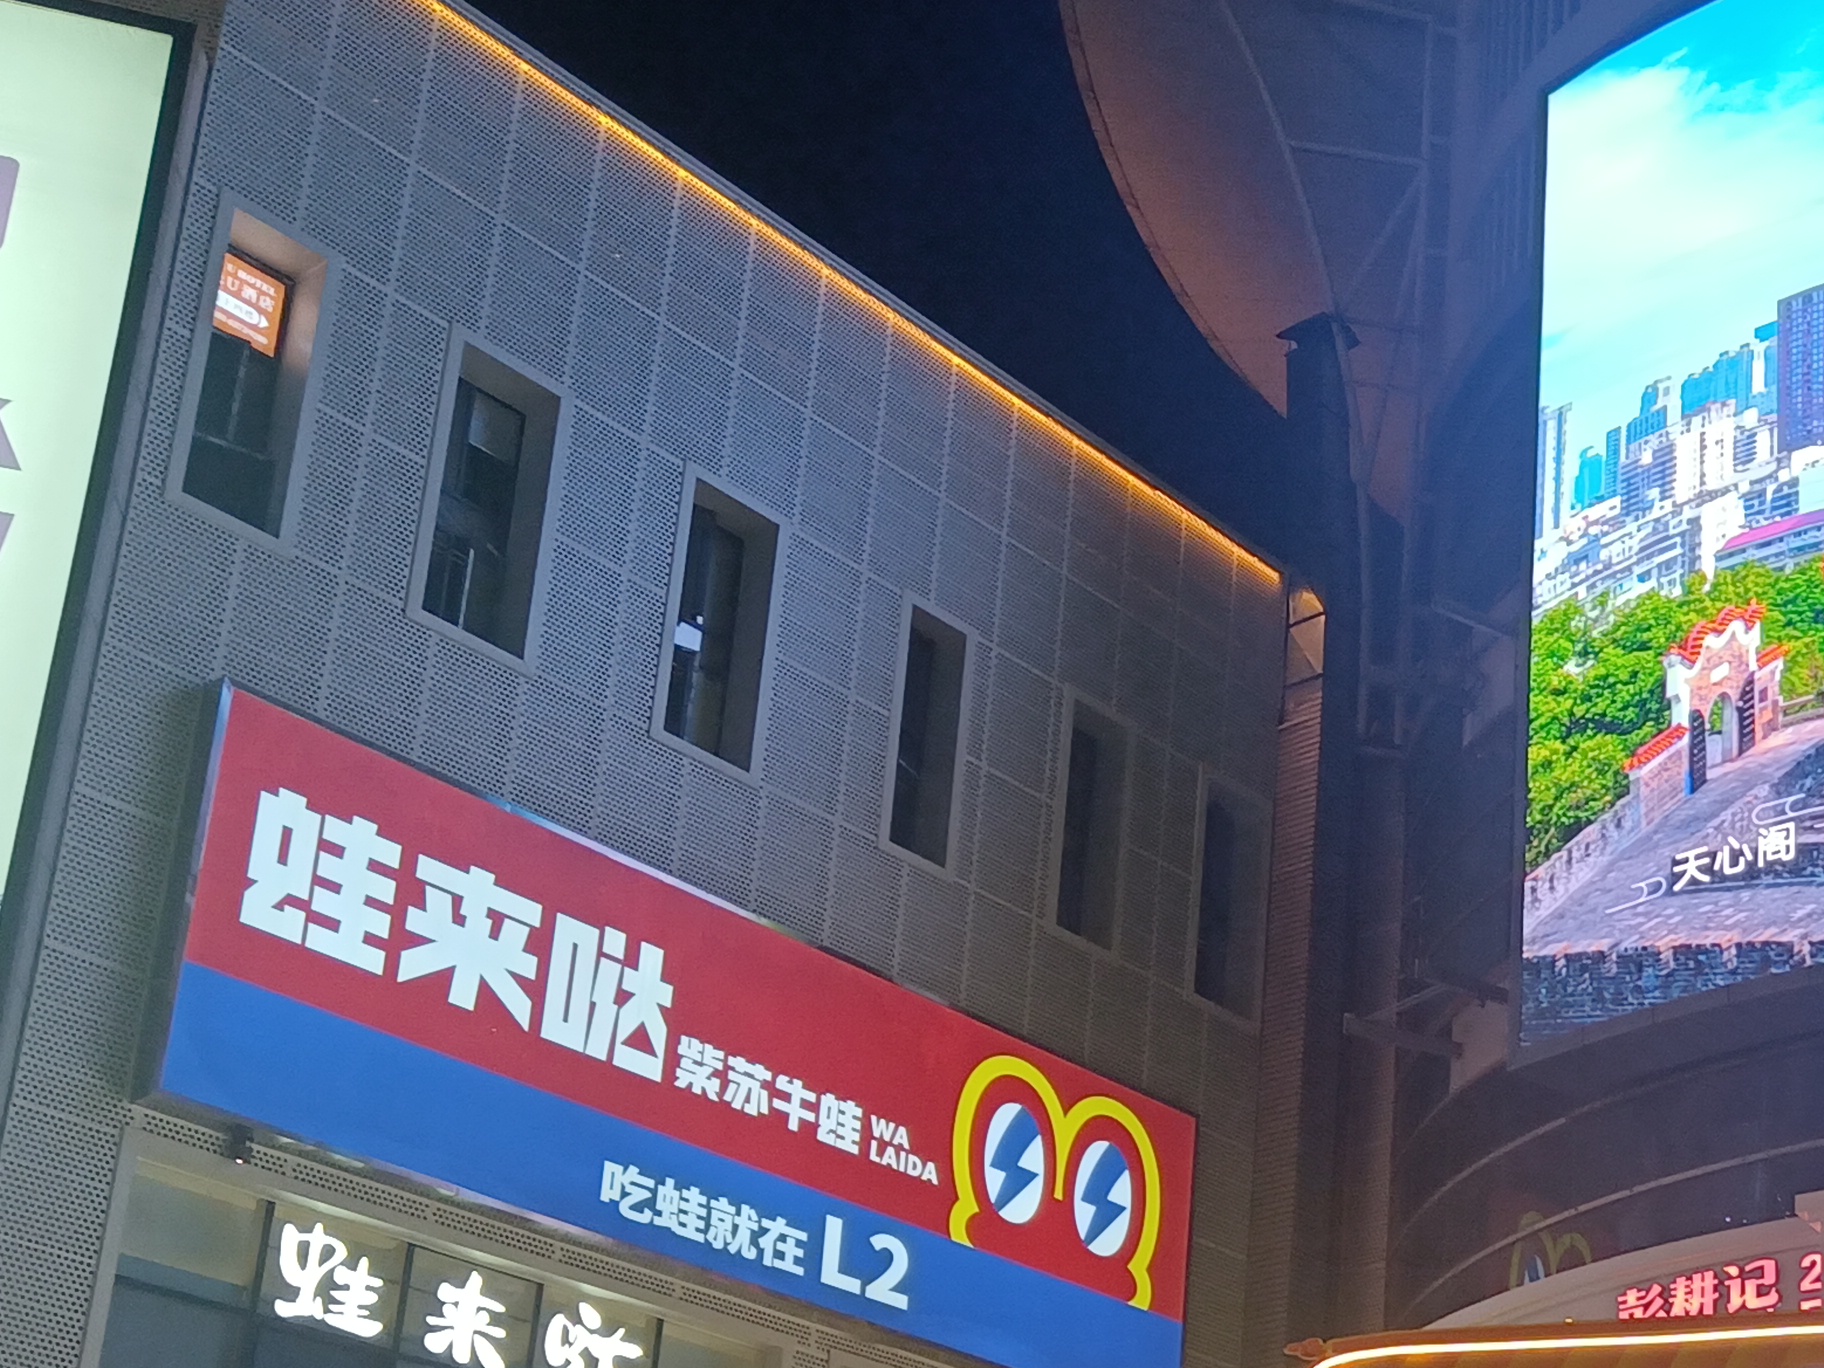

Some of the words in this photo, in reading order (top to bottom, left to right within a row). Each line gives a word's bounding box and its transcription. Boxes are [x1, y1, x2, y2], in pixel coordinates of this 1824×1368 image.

[1670, 820, 1797, 892] 天心阁
[239, 787, 674, 1083] 蛙来哒
[674, 1032, 865, 1155] 紫苏牛蛙
[868, 1141, 939, 1185] LAIDA
[870, 1113, 911, 1149] WA
